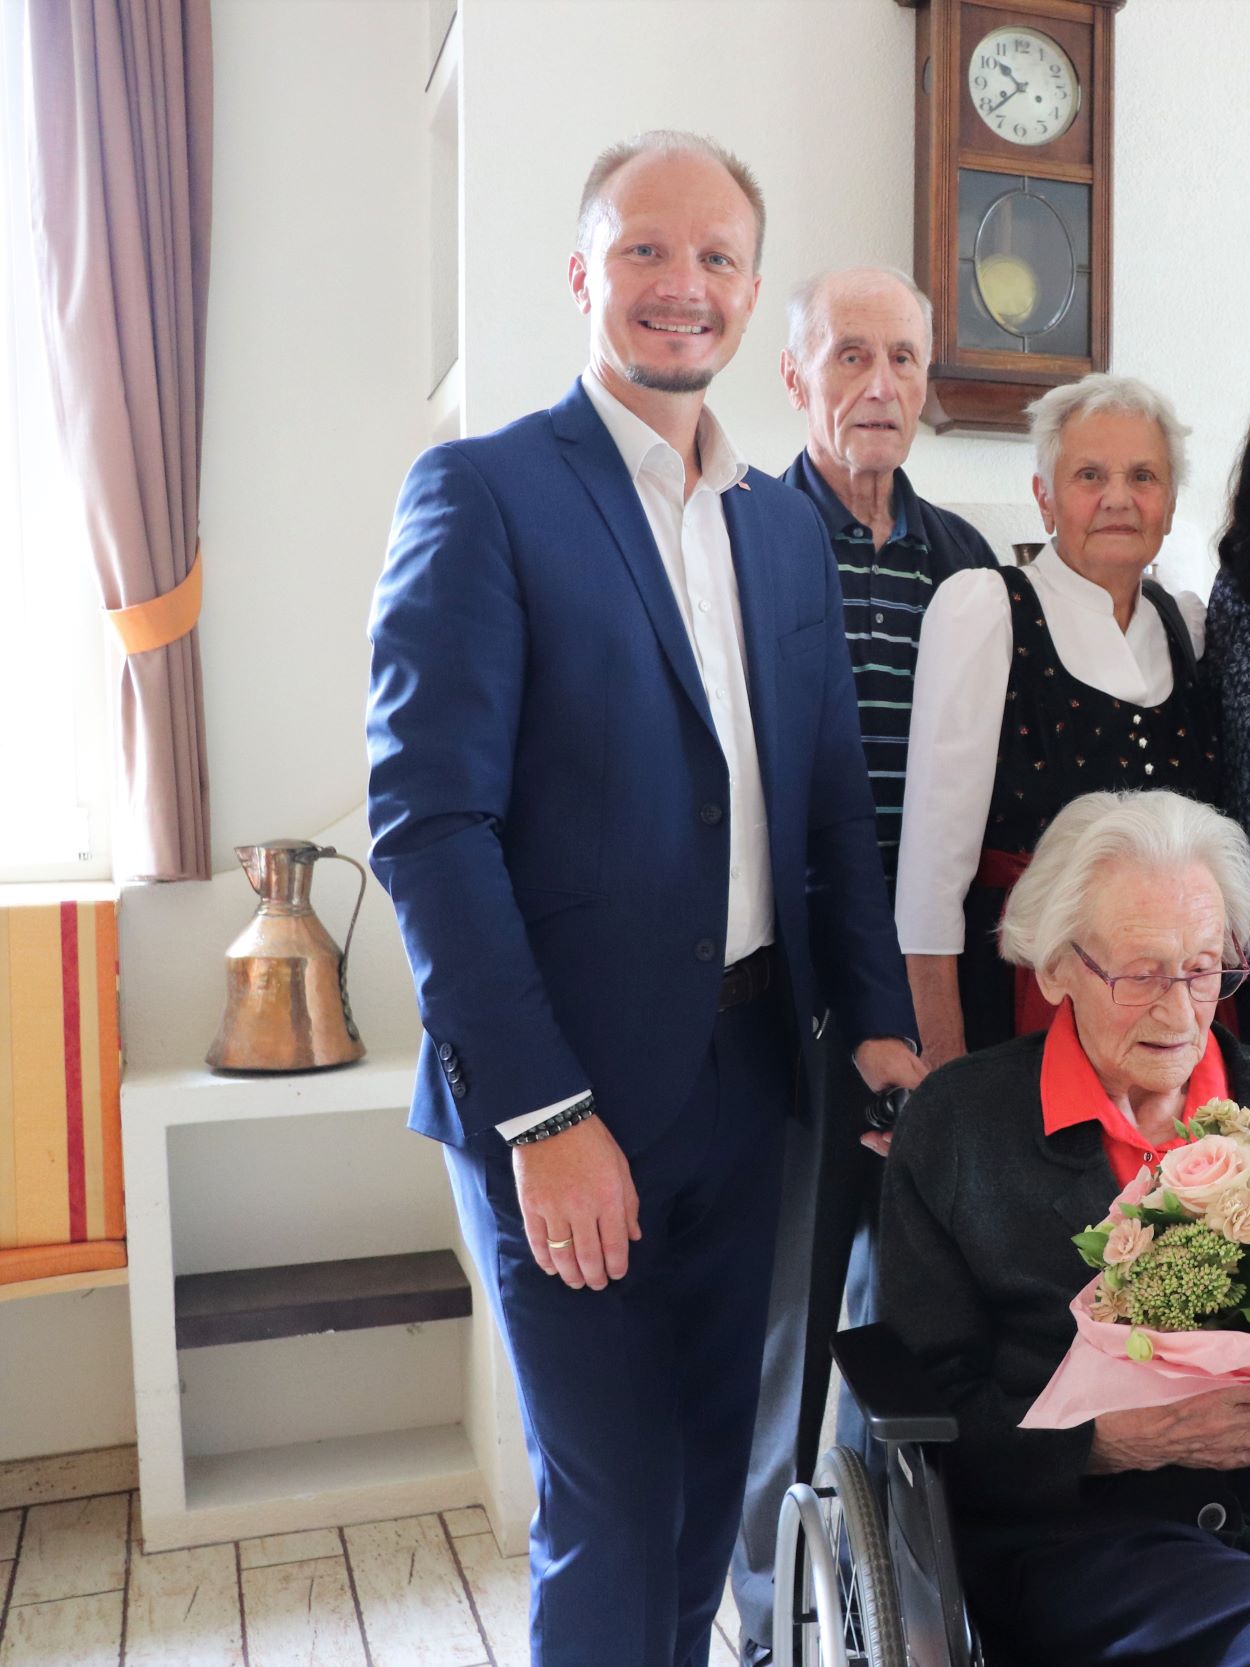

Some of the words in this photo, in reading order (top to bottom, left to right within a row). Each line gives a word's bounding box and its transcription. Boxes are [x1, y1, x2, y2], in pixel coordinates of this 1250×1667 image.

[996, 42, 1006, 56] 11
[1015, 40, 1031, 54] 12
[981, 55, 997, 70] 10
[1049, 64, 1061, 78] 2
[974, 76, 988, 90] 9
[979, 97, 993, 112] 8
[1048, 106, 1059, 120] 4
[995, 114, 1006, 128] 7
[1034, 120, 1048, 134] 5
[1013, 123, 1027, 138] 6
